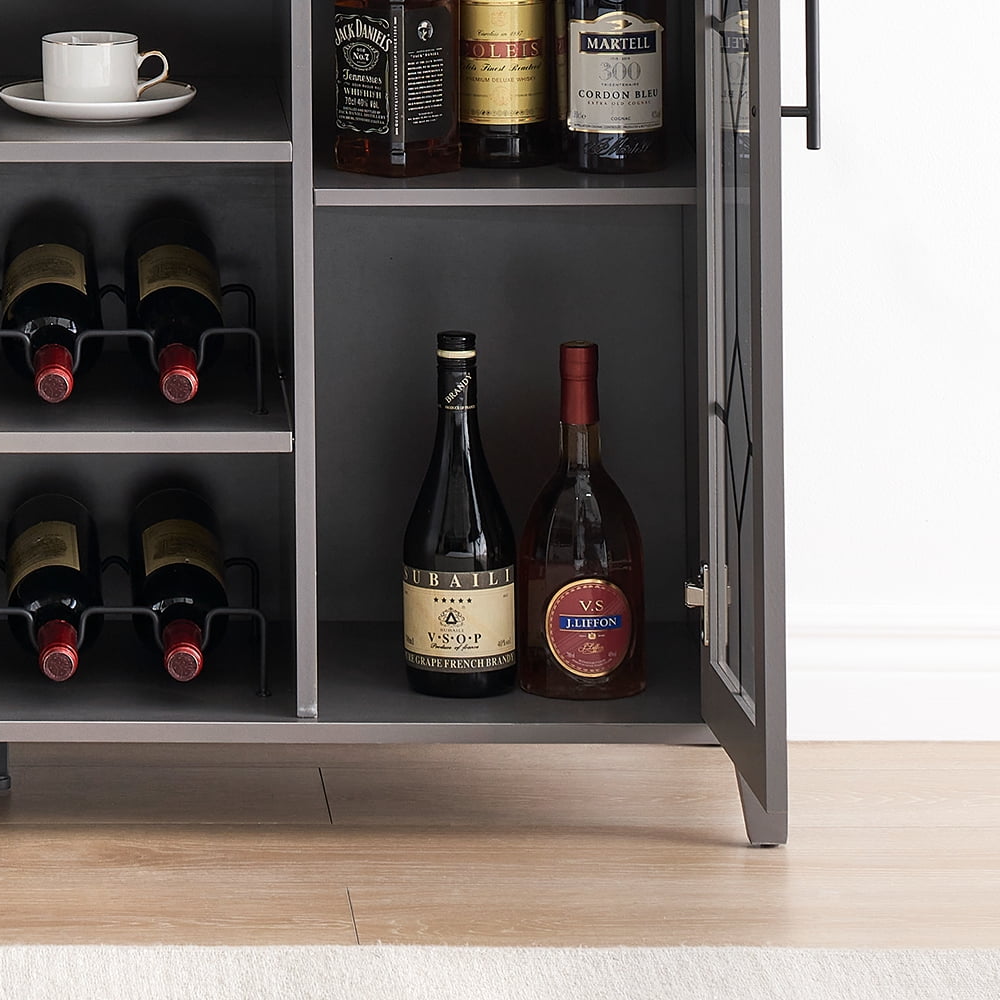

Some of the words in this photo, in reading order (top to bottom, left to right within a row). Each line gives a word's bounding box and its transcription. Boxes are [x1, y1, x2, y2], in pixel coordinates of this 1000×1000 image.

[335, 23, 356, 46] JACK
[355, 18, 393, 52] DANIEL'S
[586, 37, 650, 50] MARTELL
[599, 61, 641, 81] 300
[578, 89, 630, 100] CORDON
[634, 88, 658, 99] BLEU
[444, 372, 472, 404] BRANDY
[403, 566, 510, 588] SUBAILI
[579, 600, 605, 612] V.S
[565, 617, 617, 629] J.LIFFON
[454, 643, 461, 653] of
[415, 655, 443, 668] GRAPE
[444, 660, 485, 669] FRENCH
[486, 652, 514, 666] BRANDY
